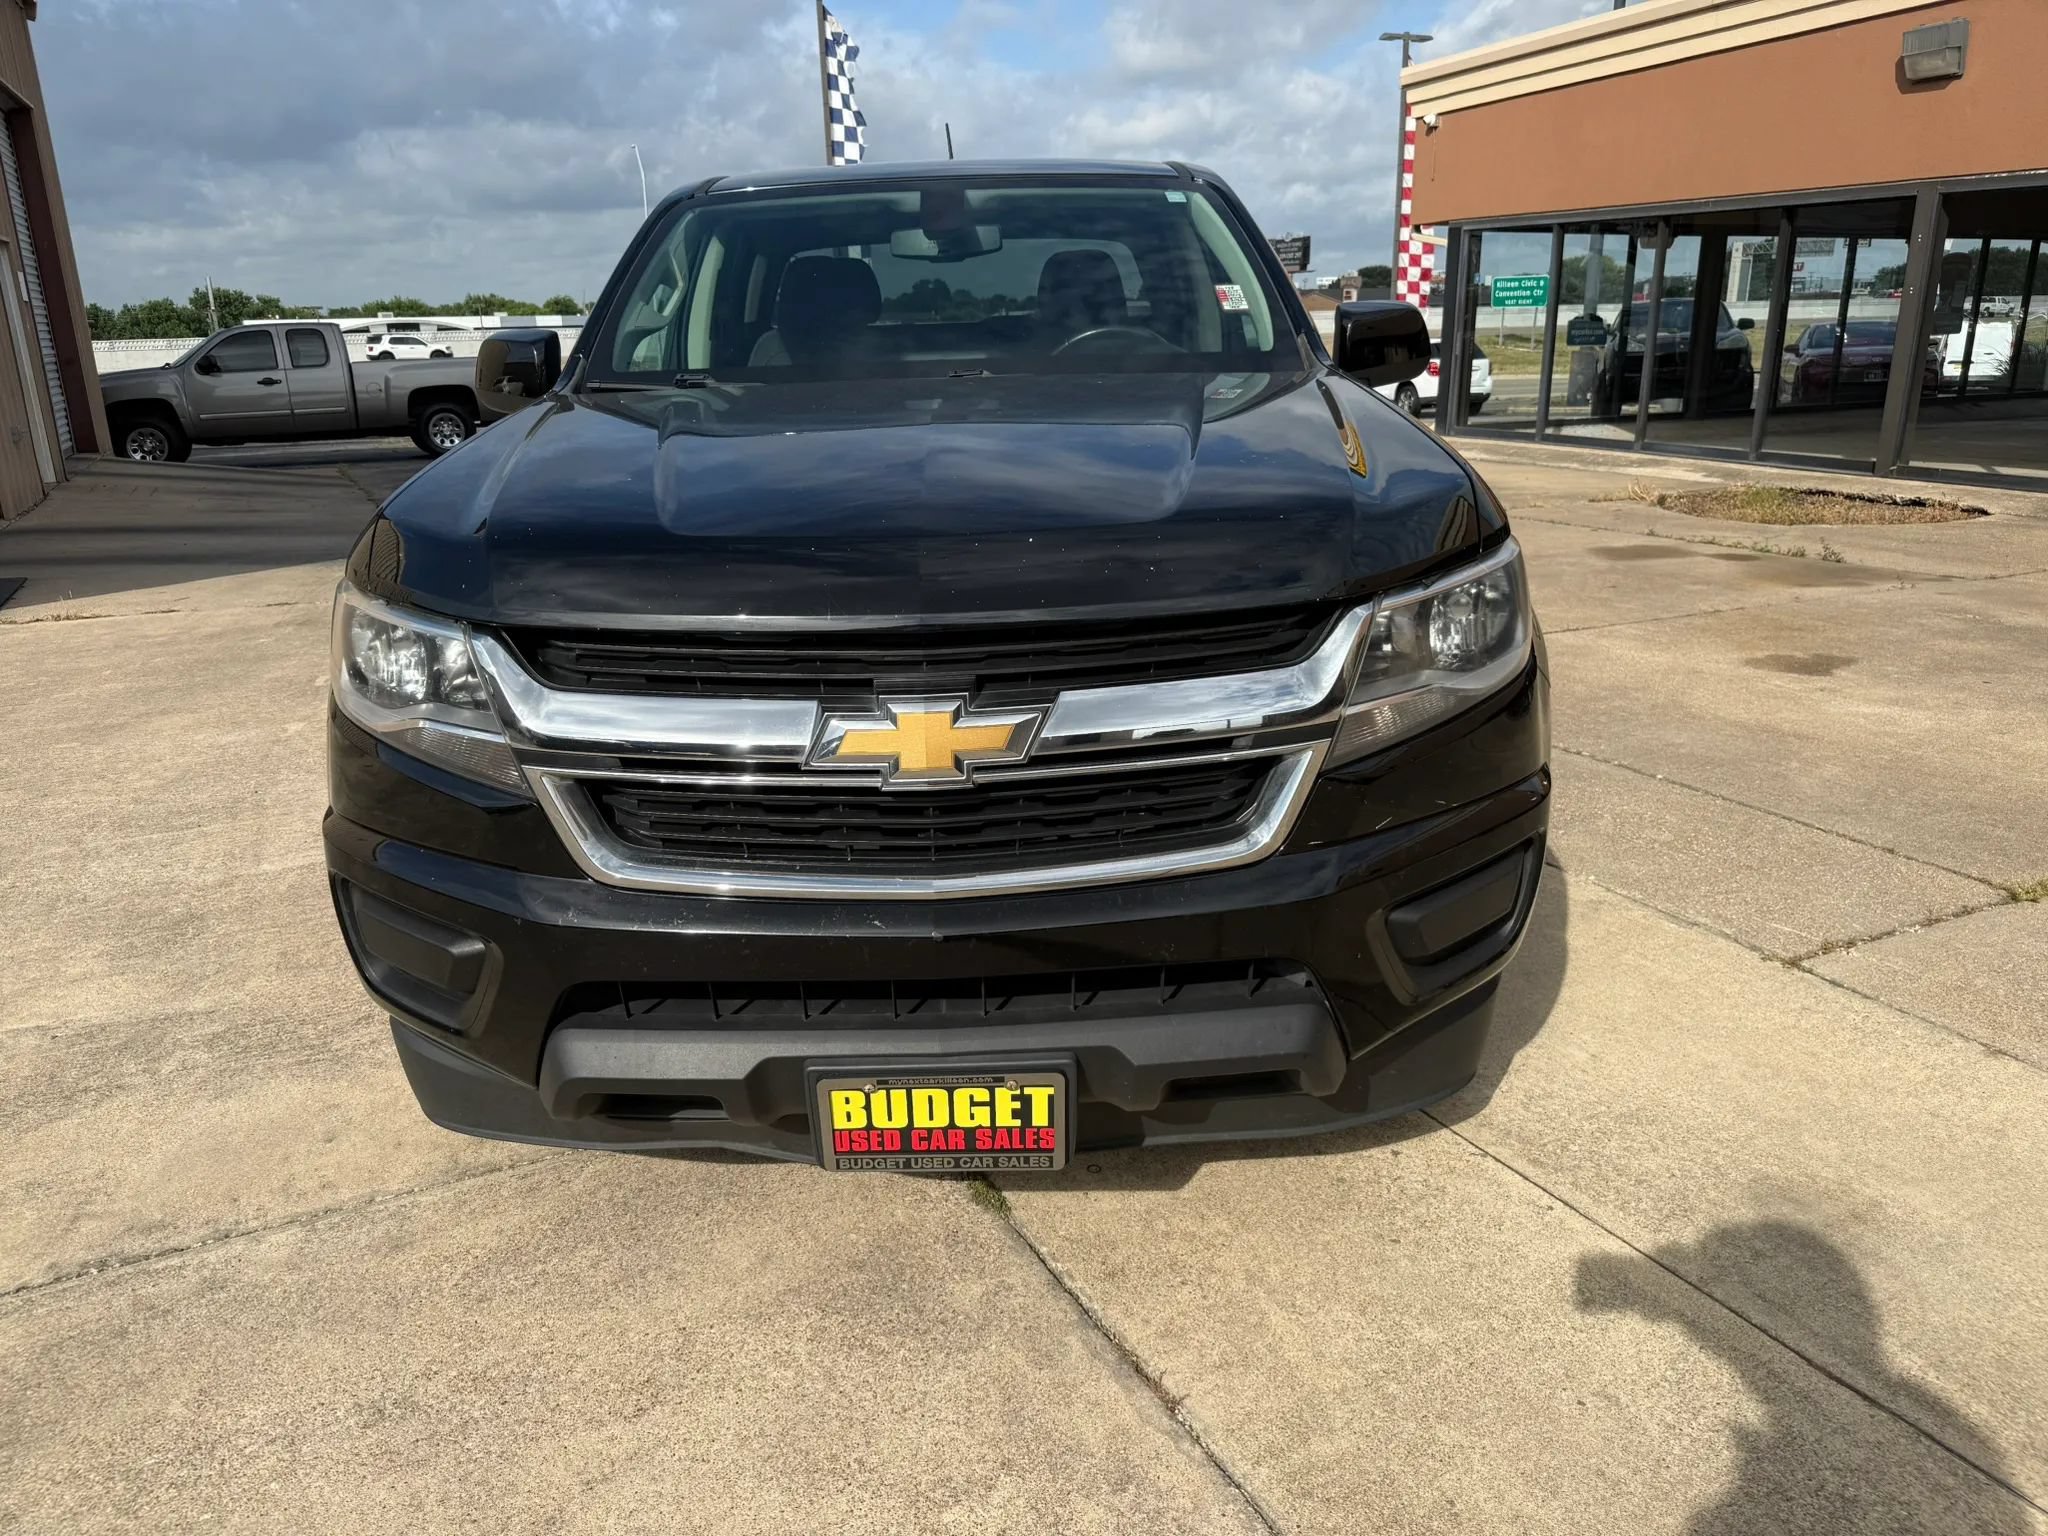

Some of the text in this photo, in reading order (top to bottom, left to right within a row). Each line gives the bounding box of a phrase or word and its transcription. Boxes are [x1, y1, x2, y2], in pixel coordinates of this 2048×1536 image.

[1496, 280, 1519, 288] Killeen
[888, 1076, 995, 1086] mynextcarkilleen.com
[831, 1087, 1056, 1129] BUDGET
[834, 1127, 1056, 1152] USED CAR SALES
[839, 1156, 1050, 1170] BUDGET USED CAR SALES
